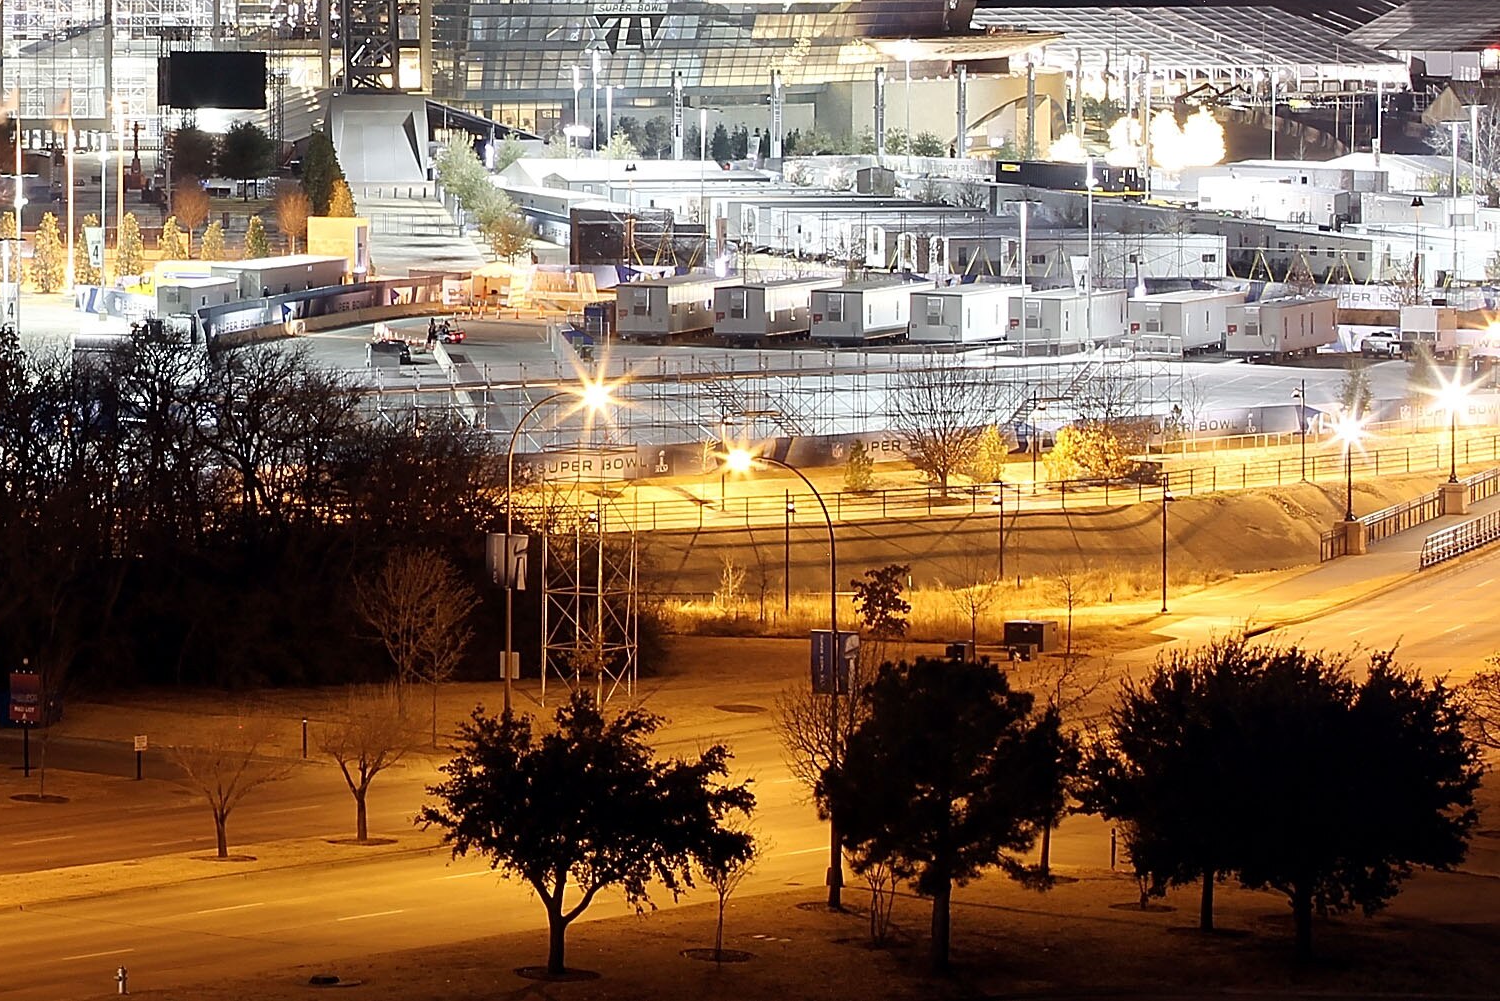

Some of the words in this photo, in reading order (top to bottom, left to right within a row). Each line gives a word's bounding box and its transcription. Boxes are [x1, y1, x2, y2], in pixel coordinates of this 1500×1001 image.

[598, 3, 632, 12] SUPER
[637, 3, 664, 12] BOWL
[580, 16, 669, 56] XLV
[92, 245, 99, 260] 4
[1078, 274, 1086, 290] 4
[7, 302, 14, 319] 4
[1198, 418, 1238, 432] BOWL
[538, 460, 593, 474] SUPER
[601, 457, 648, 471] BOWL
